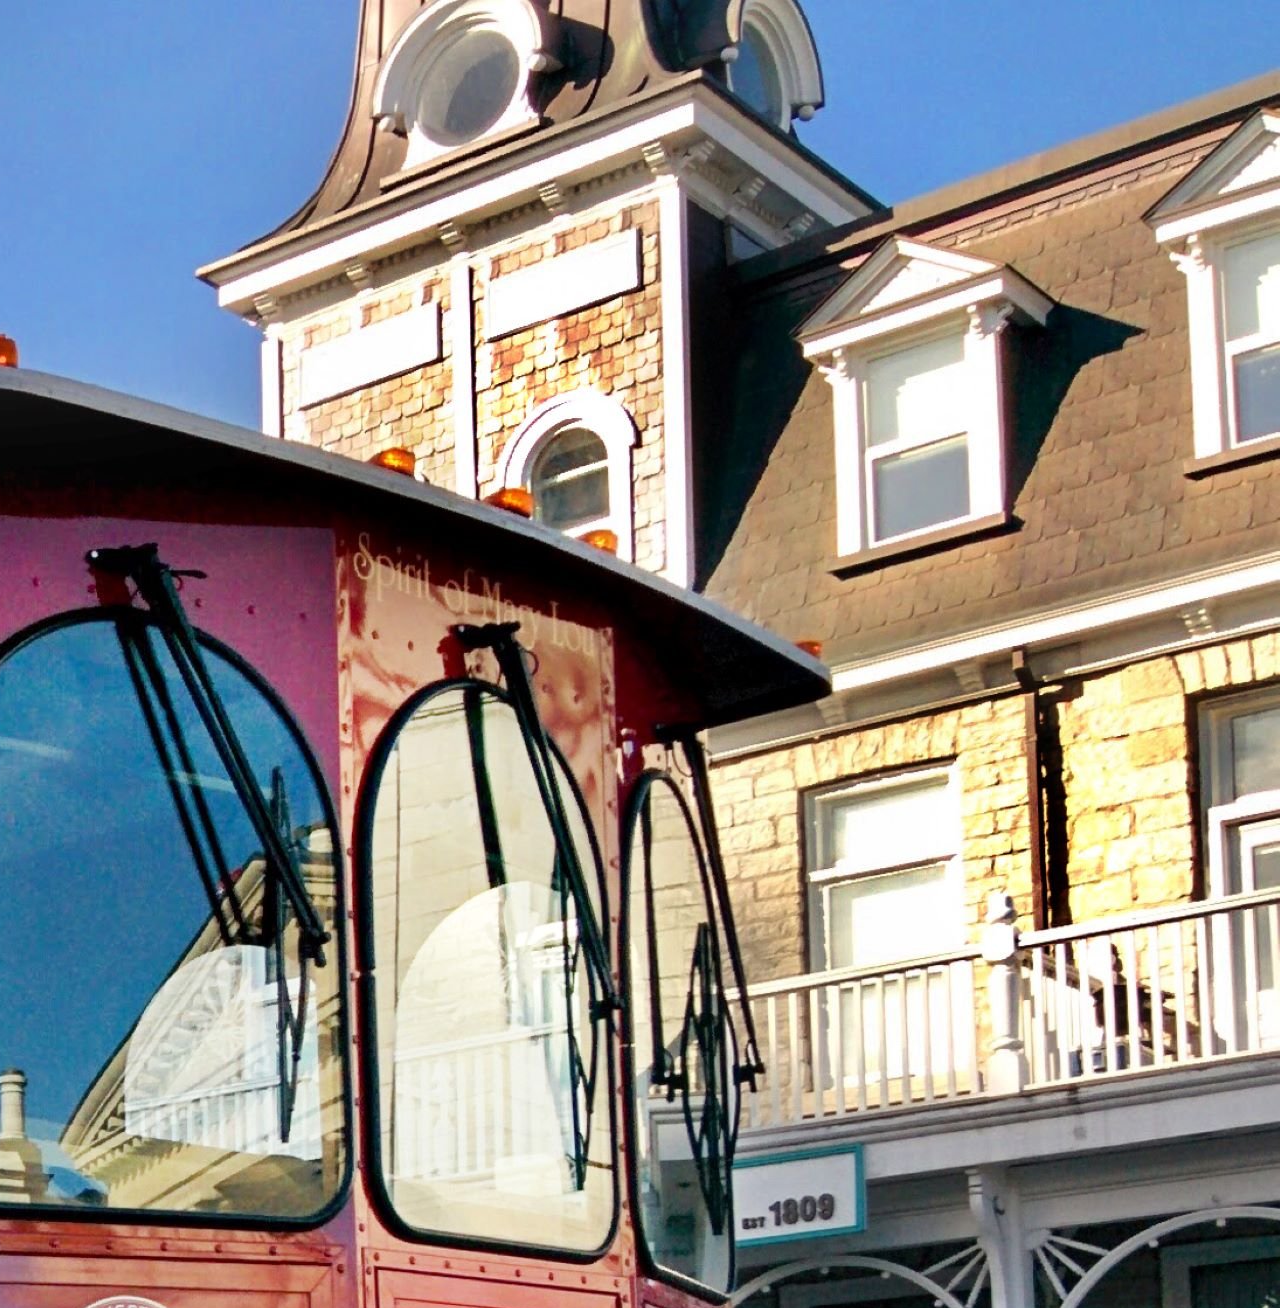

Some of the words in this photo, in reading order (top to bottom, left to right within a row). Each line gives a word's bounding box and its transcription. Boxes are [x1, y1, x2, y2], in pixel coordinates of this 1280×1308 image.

[354, 532, 436, 602] Spirit
[445, 568, 474, 613] of
[550, 601, 596, 657] Lou
[742, 1216, 765, 1229] EST
[768, 1193, 834, 1226] 1809
